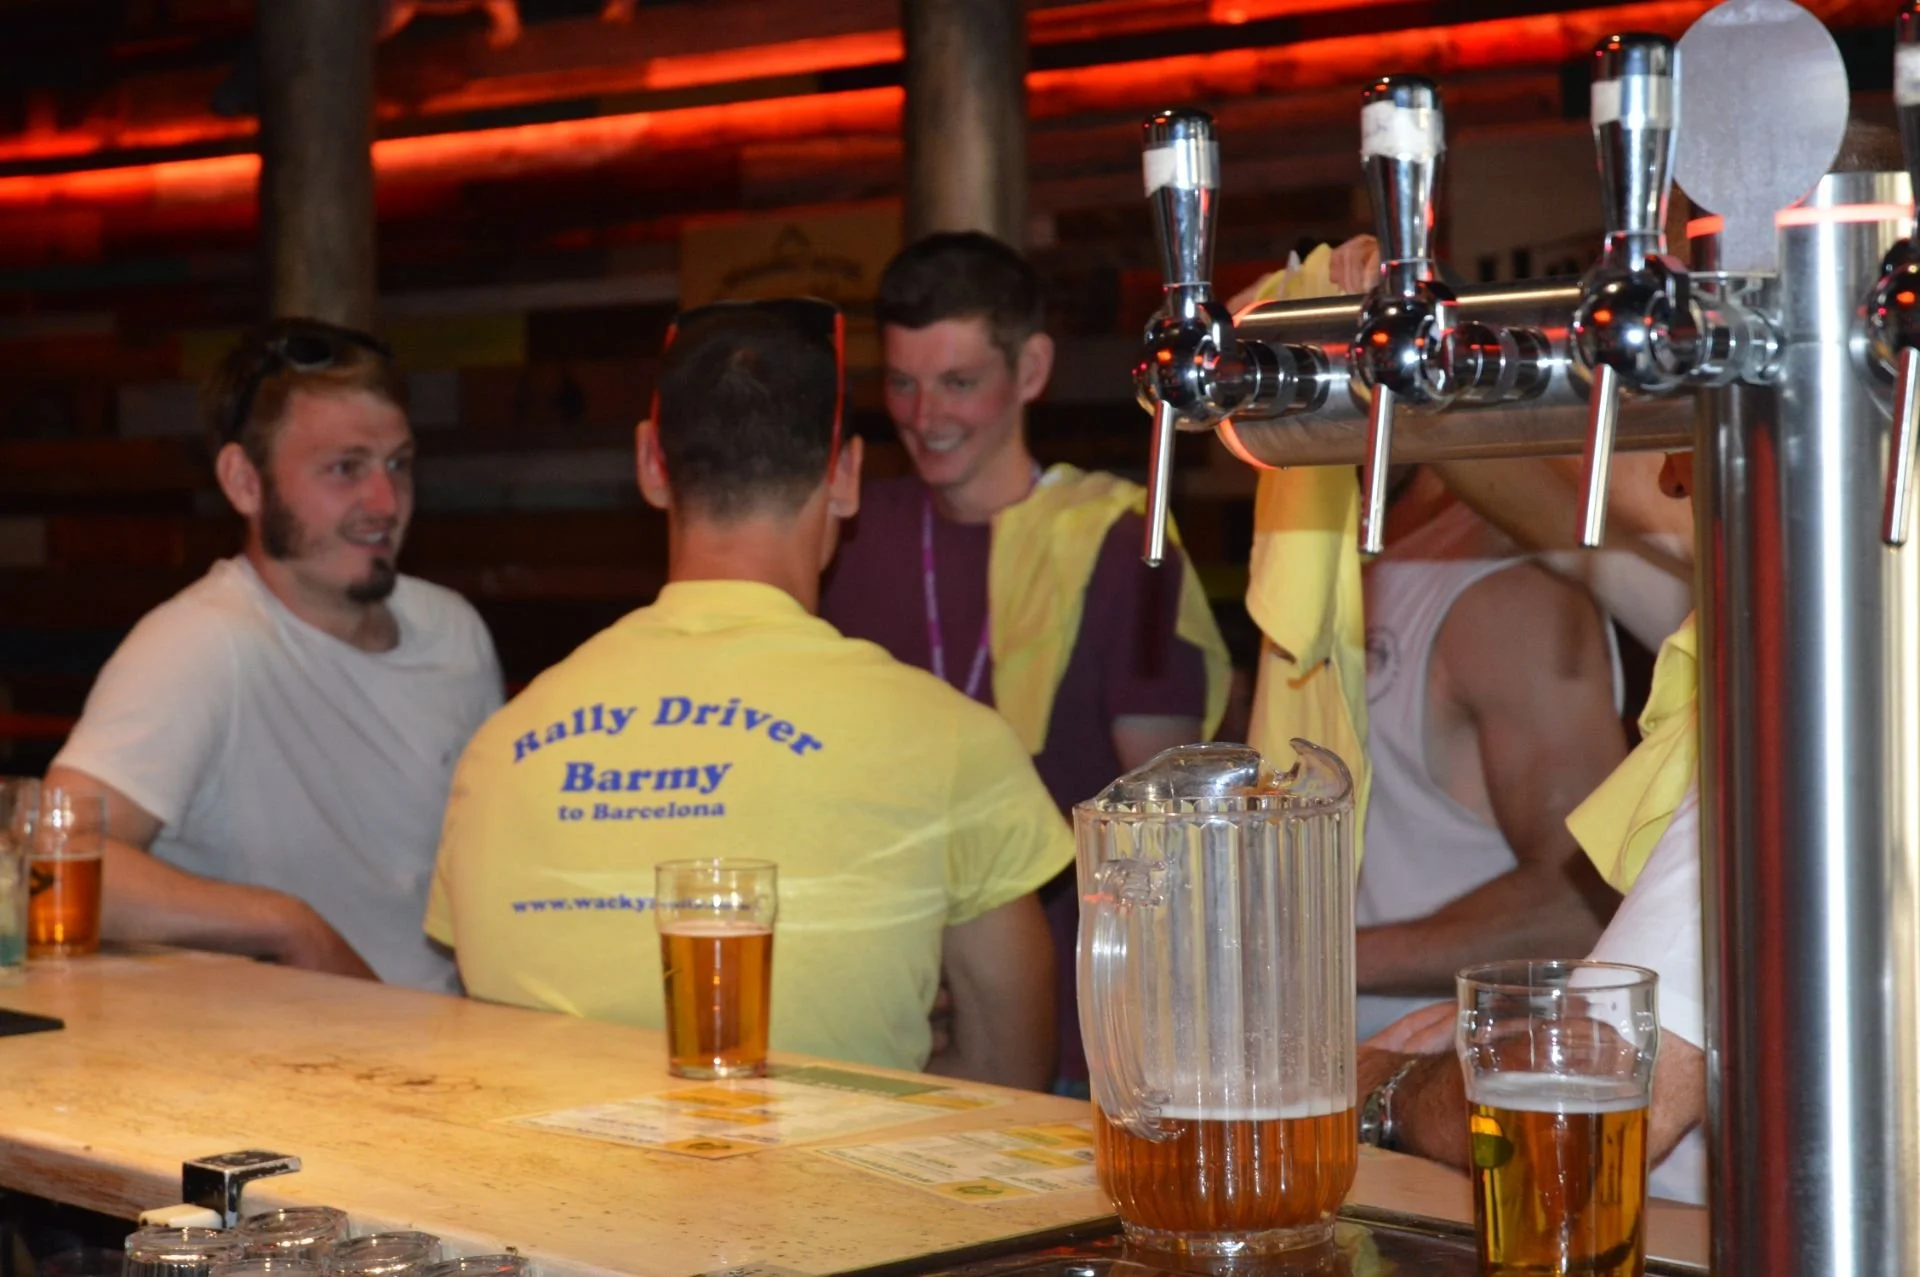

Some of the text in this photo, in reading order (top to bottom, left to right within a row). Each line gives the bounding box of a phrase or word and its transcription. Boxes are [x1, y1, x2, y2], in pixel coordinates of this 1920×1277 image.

[512, 696, 823, 763] Rally Driver
[561, 761, 732, 795] Barmy
[558, 802, 726, 821] to Barcelona
